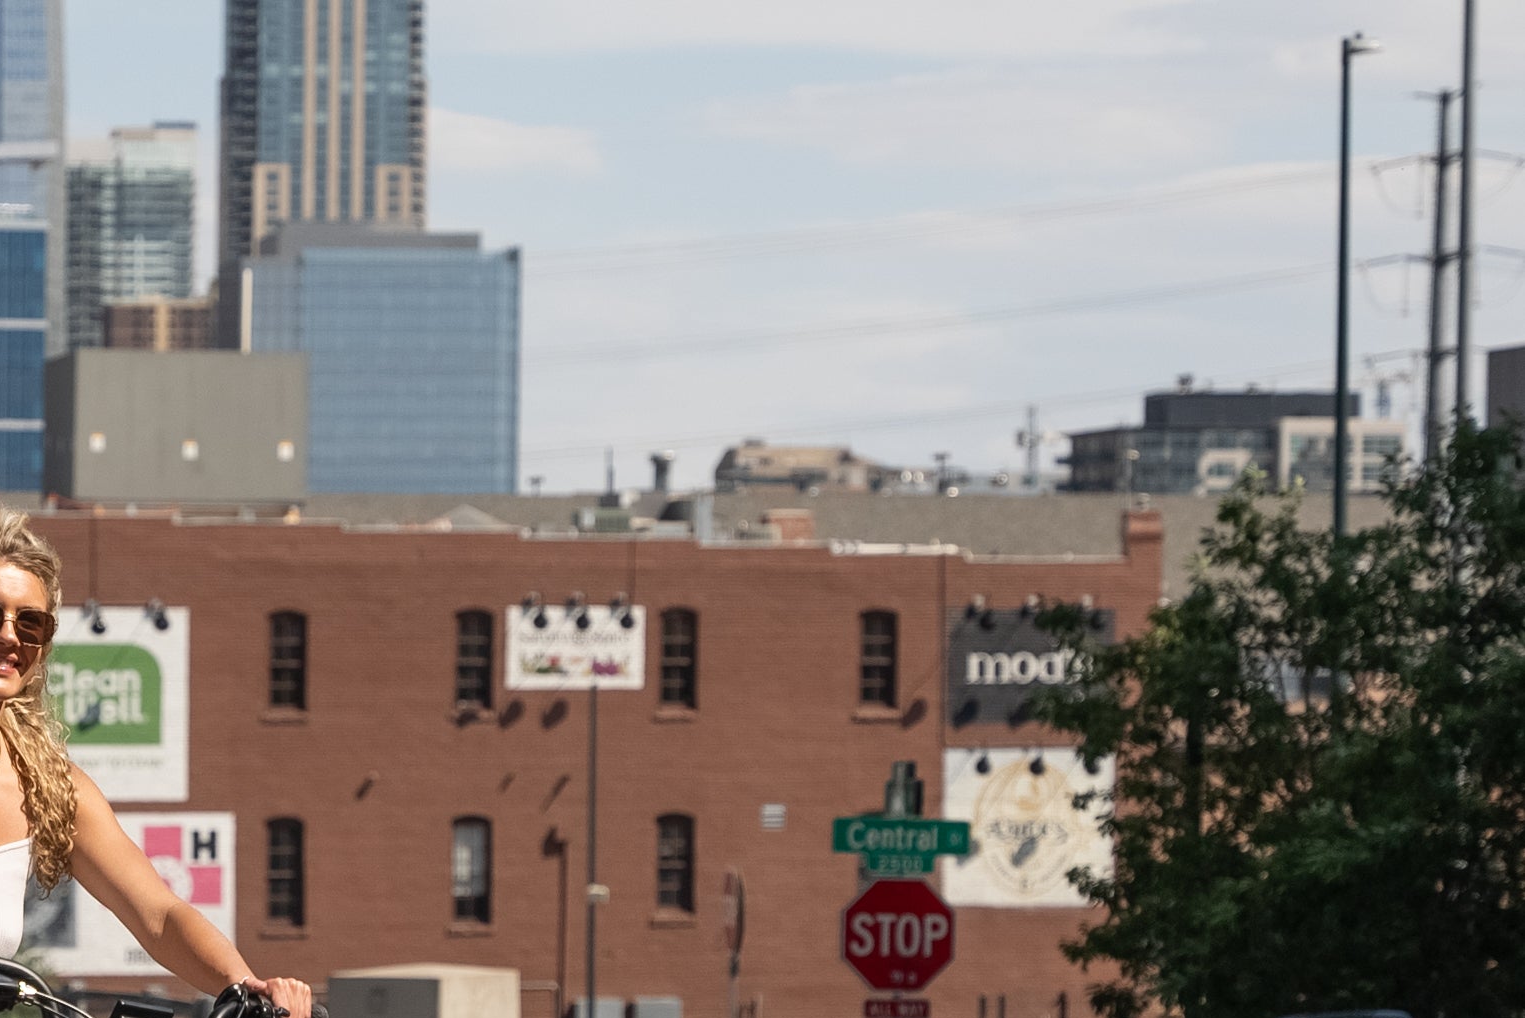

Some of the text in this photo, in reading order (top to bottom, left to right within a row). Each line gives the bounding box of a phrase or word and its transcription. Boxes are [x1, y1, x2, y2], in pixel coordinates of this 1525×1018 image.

[46, 662, 142, 696] Clean
[193, 831, 216, 860] H
[847, 822, 938, 851] Central
[848, 911, 949, 958] STOP
